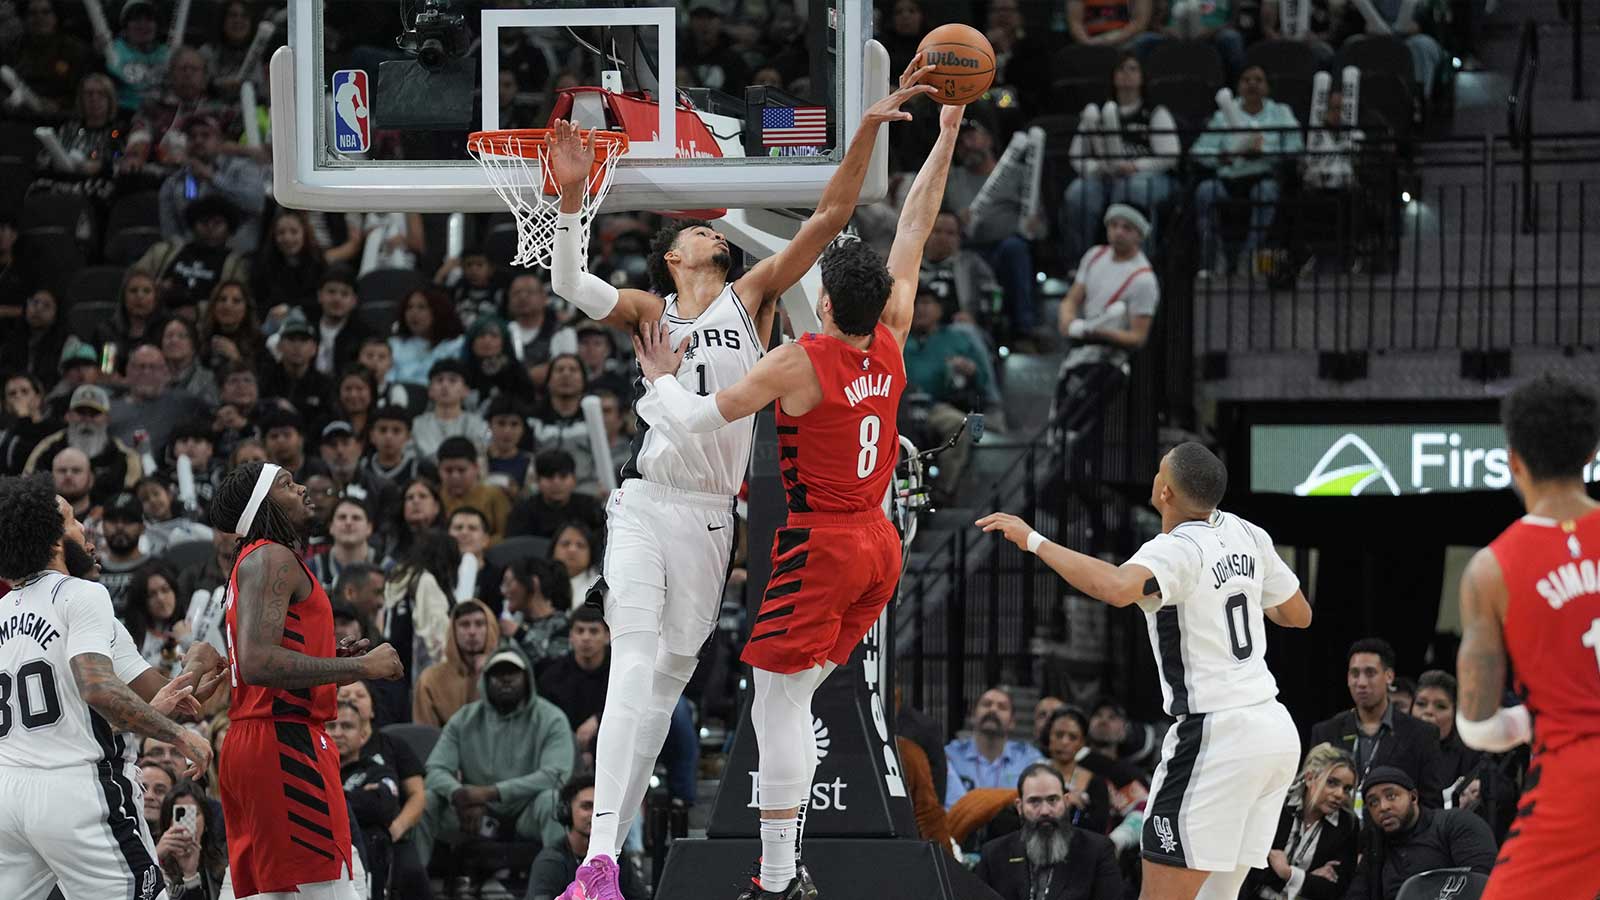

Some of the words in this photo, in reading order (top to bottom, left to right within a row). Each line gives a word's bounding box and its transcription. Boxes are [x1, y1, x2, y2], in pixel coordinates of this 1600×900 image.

[927, 51, 979, 69] Wilson
[340, 134, 357, 148] NBA
[696, 364, 710, 397] 1
[844, 373, 892, 407] AVDIJA
[857, 414, 881, 480] 8
[1411, 433, 1513, 489] Firs
[1212, 553, 1255, 590] JOHNSON
[1536, 559, 1600, 611] SIMO
[0, 612, 61, 651] MPAGNIE
[1225, 591, 1253, 662] 0
